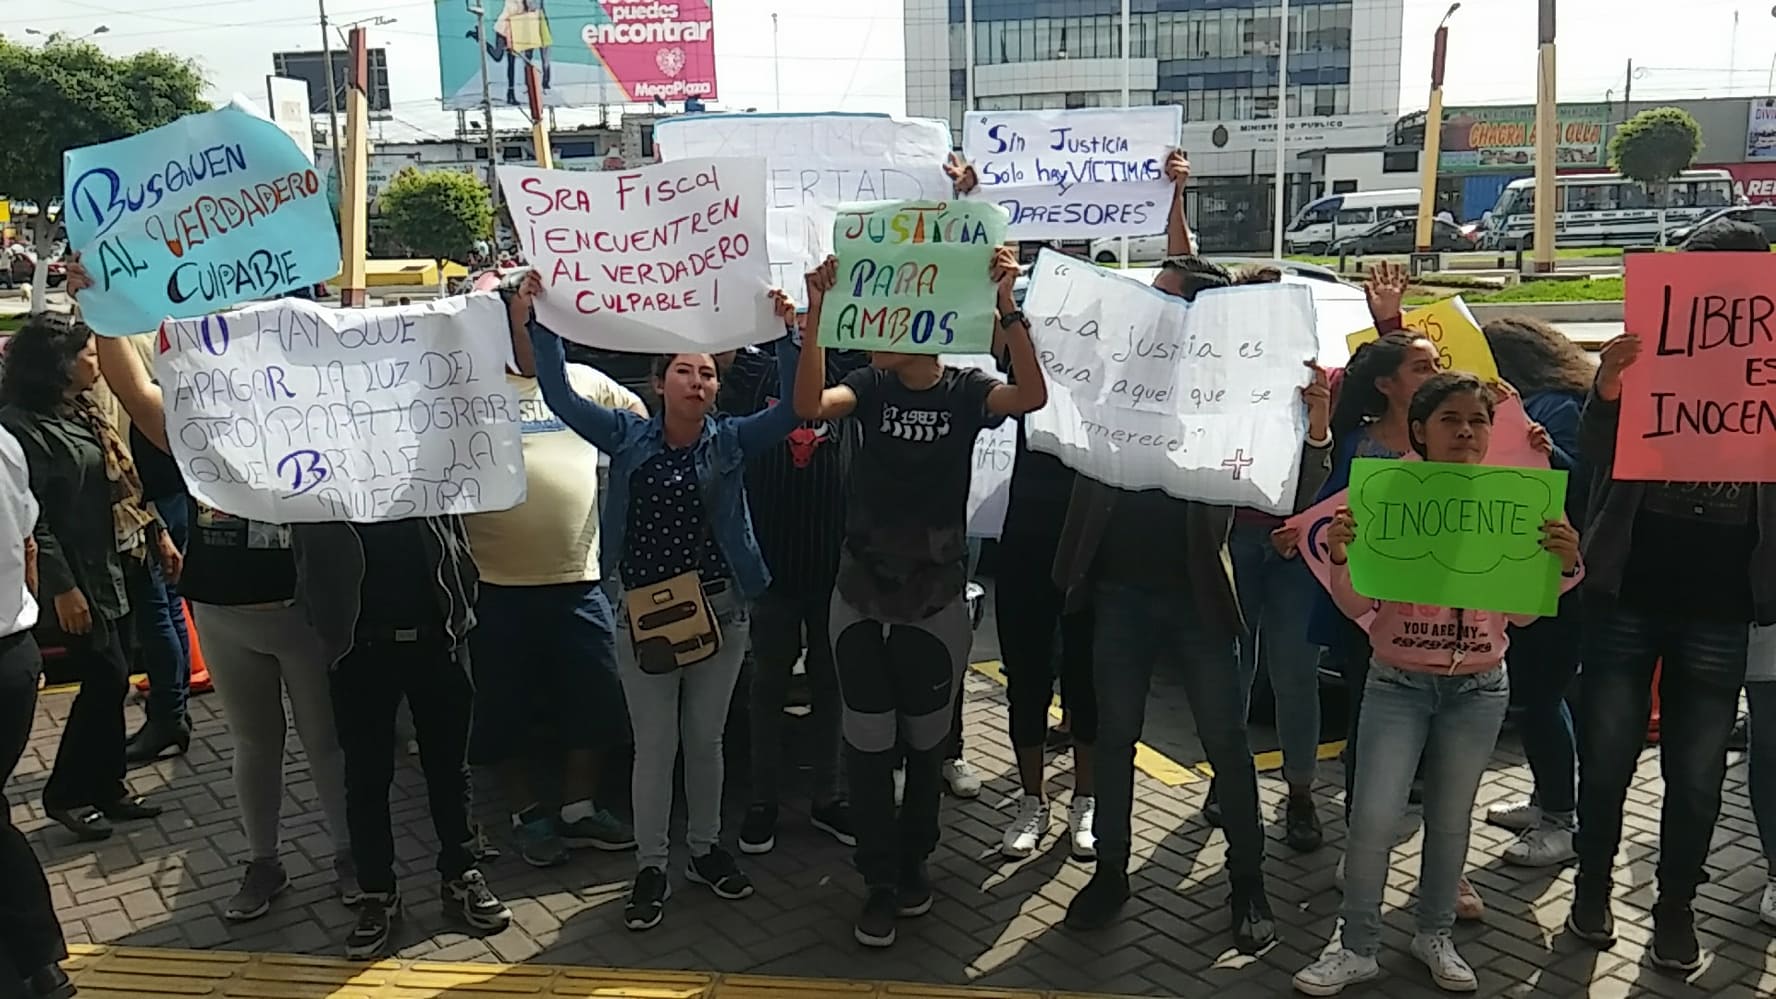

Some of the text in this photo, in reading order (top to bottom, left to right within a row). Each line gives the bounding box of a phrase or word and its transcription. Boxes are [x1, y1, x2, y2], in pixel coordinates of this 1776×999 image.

[582, 19, 712, 44] encontrar
[612, 1, 679, 23] puedes
[635, 81, 711, 99] MegaPlaza
[1241, 122, 1295, 132] MINISTEIO
[71, 143, 247, 238] BUSQUEN
[521, 177, 590, 216] SRA
[771, 167, 925, 209] ERTAD
[99, 168, 319, 292] AL VERDADERO
[551, 257, 592, 287] AL
[601, 233, 750, 284] VERDADERO
[849, 257, 939, 298] PARA
[255, 308, 321, 352] HAY
[336, 316, 417, 350] QUE
[836, 303, 959, 346] AMBOS
[1657, 285, 1775, 357] LIBER
[1238, 338, 1265, 359] es
[173, 350, 481, 412] APAGAR LA LUZ DEL
[1111, 378, 1174, 406] aquel
[1190, 388, 1227, 408] que
[1251, 389, 1273, 404] se
[179, 393, 517, 452] OTRO PARA LOGRAR
[189, 455, 267, 485] QUE
[316, 474, 482, 520] NUESTRA
[1375, 498, 1529, 541] INOCENTE
[1403, 621, 1429, 635] YOU
[1431, 624, 1456, 636] ARE
